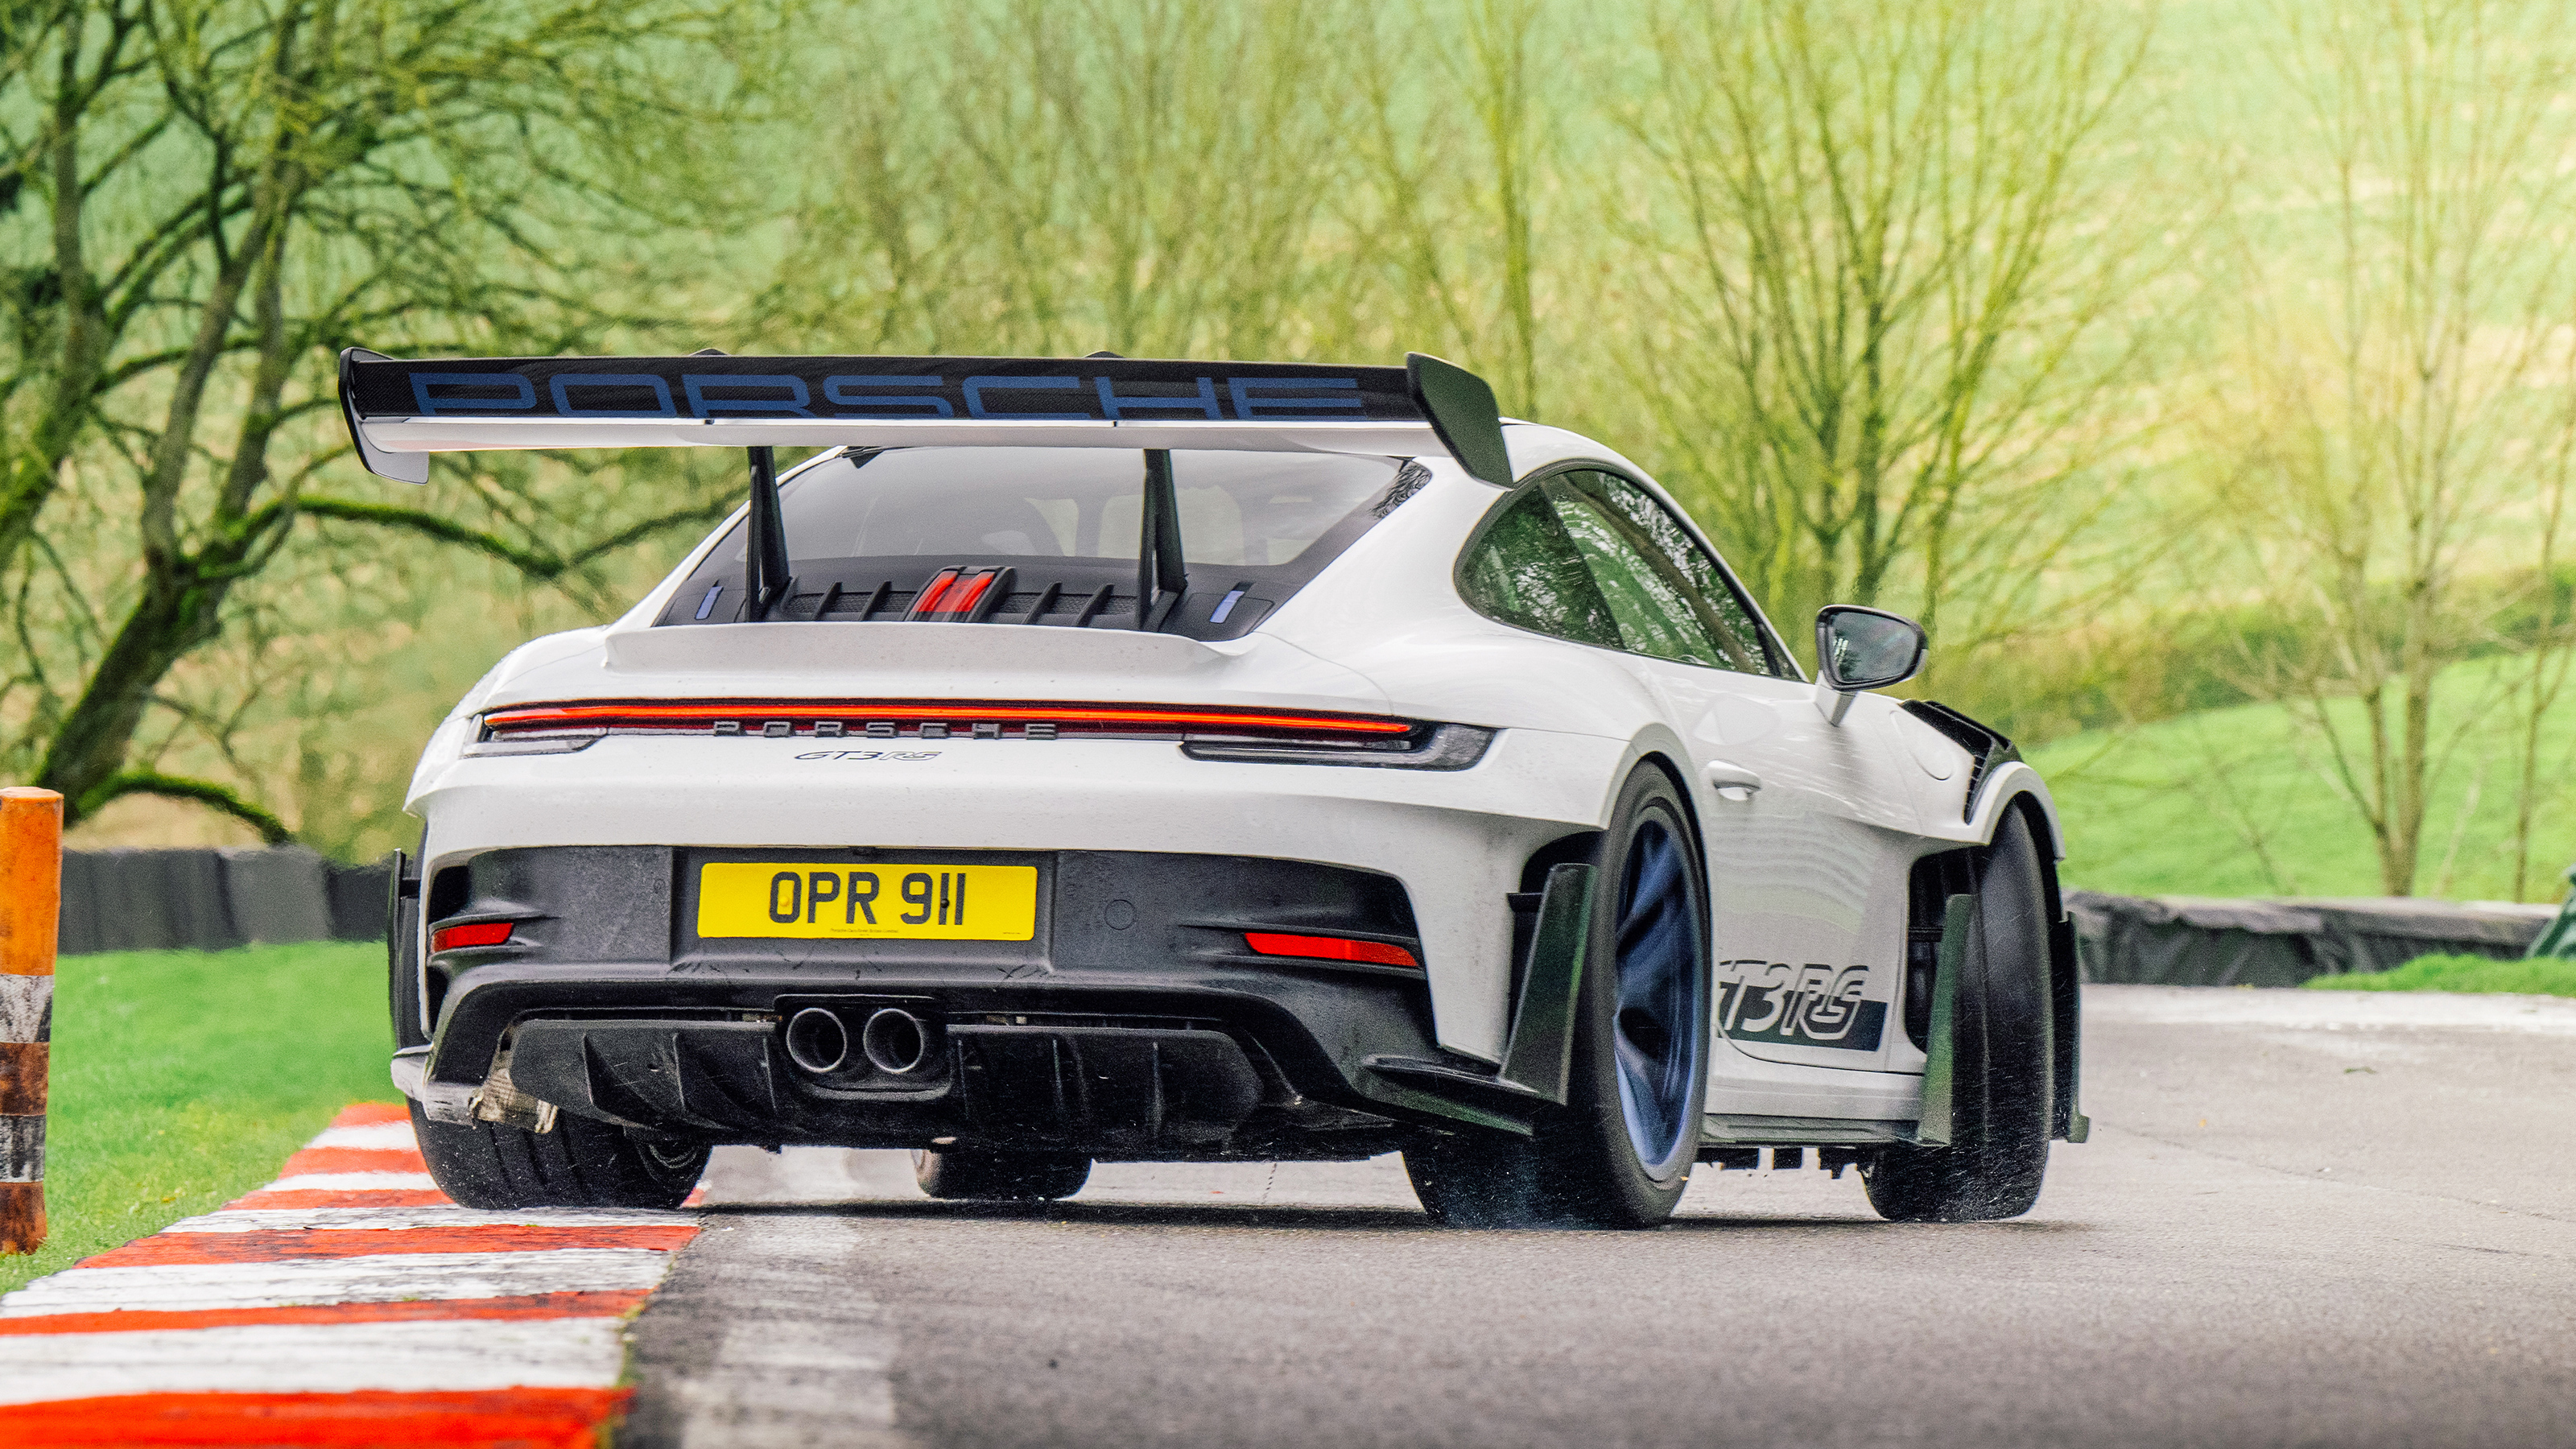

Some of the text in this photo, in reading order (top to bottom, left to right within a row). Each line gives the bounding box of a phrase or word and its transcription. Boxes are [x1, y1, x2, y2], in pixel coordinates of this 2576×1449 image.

[408, 372, 1366, 419] PORSCHE
[713, 721, 1056, 738] PORSCHE
[769, 871, 966, 925] OPR 911
